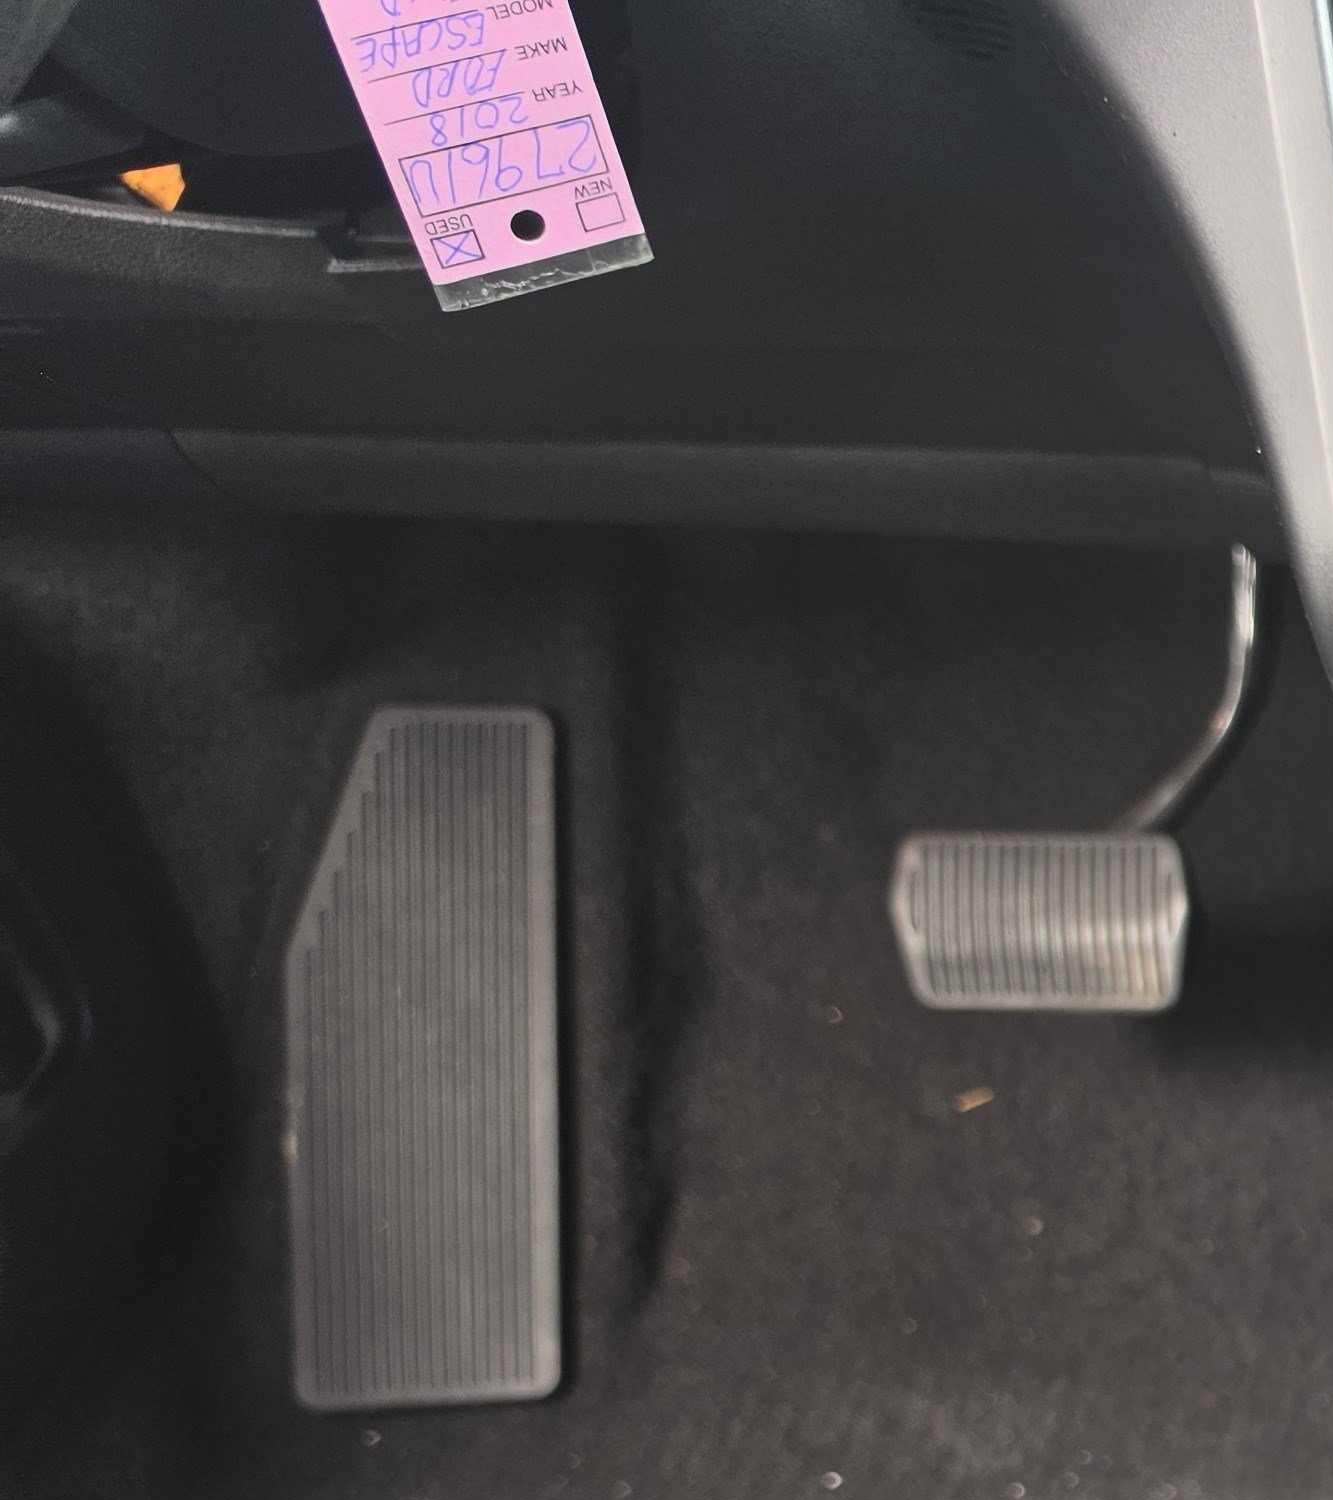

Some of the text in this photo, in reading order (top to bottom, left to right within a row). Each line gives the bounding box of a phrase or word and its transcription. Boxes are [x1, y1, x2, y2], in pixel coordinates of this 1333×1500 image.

[355, 12, 485, 73] ESCAPE
[516, 36, 568, 61] MAKE
[412, 50, 506, 108] FORD
[533, 80, 583, 103] YEAR
[428, 96, 529, 147] 2018
[408, 119, 597, 204] 27961U
[574, 177, 614, 200] NEW
[424, 213, 473, 237] USED
